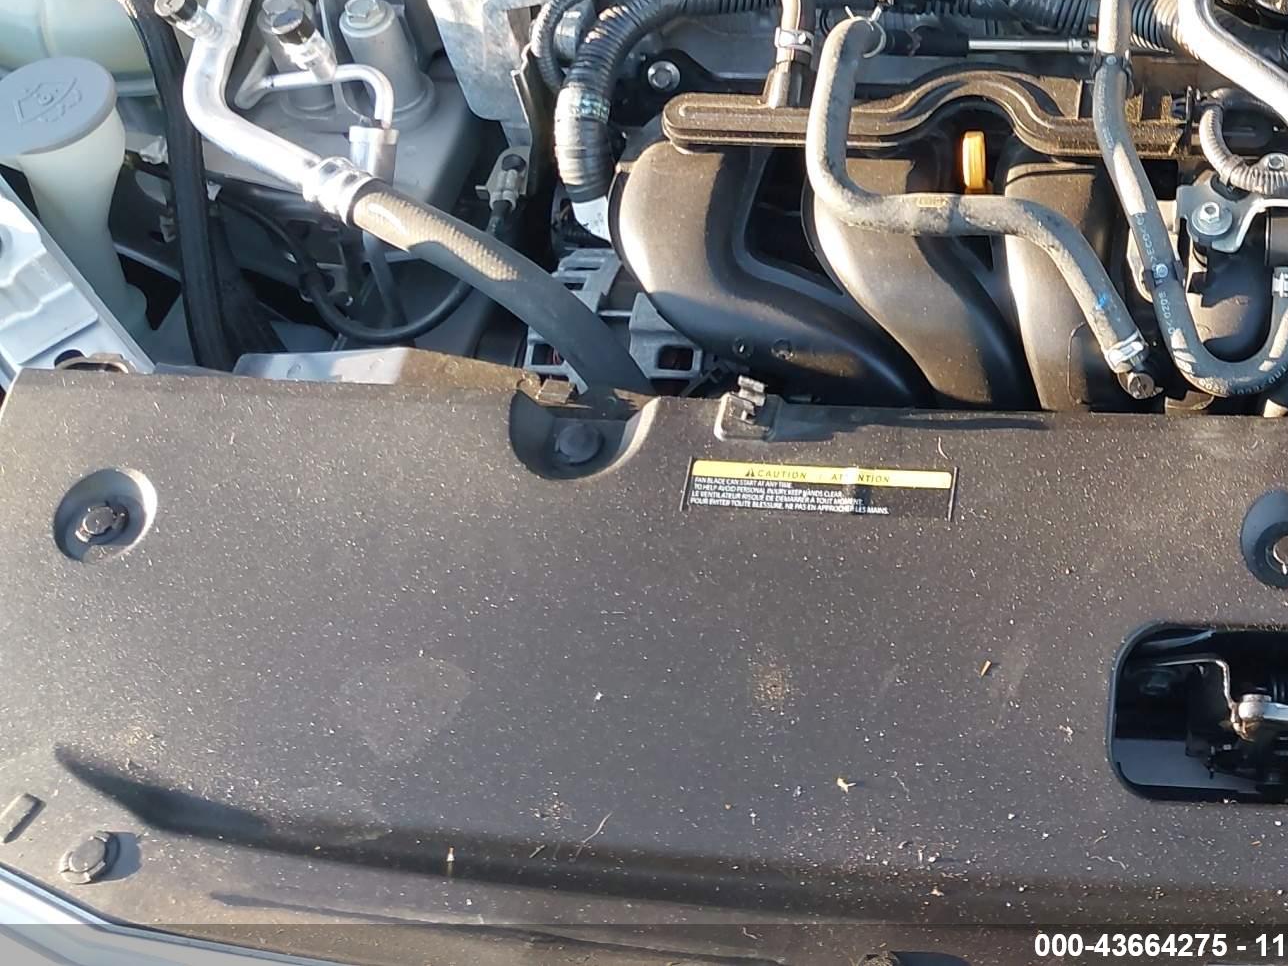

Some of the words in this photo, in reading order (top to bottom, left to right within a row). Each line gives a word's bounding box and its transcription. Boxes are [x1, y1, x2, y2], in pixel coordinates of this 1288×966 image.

[757, 470, 806, 479] CAUTION
[737, 486, 765, 494] PERSONAL
[701, 491, 740, 499] VENTILATEUR
[818, 504, 853, 512] APPROCHER
